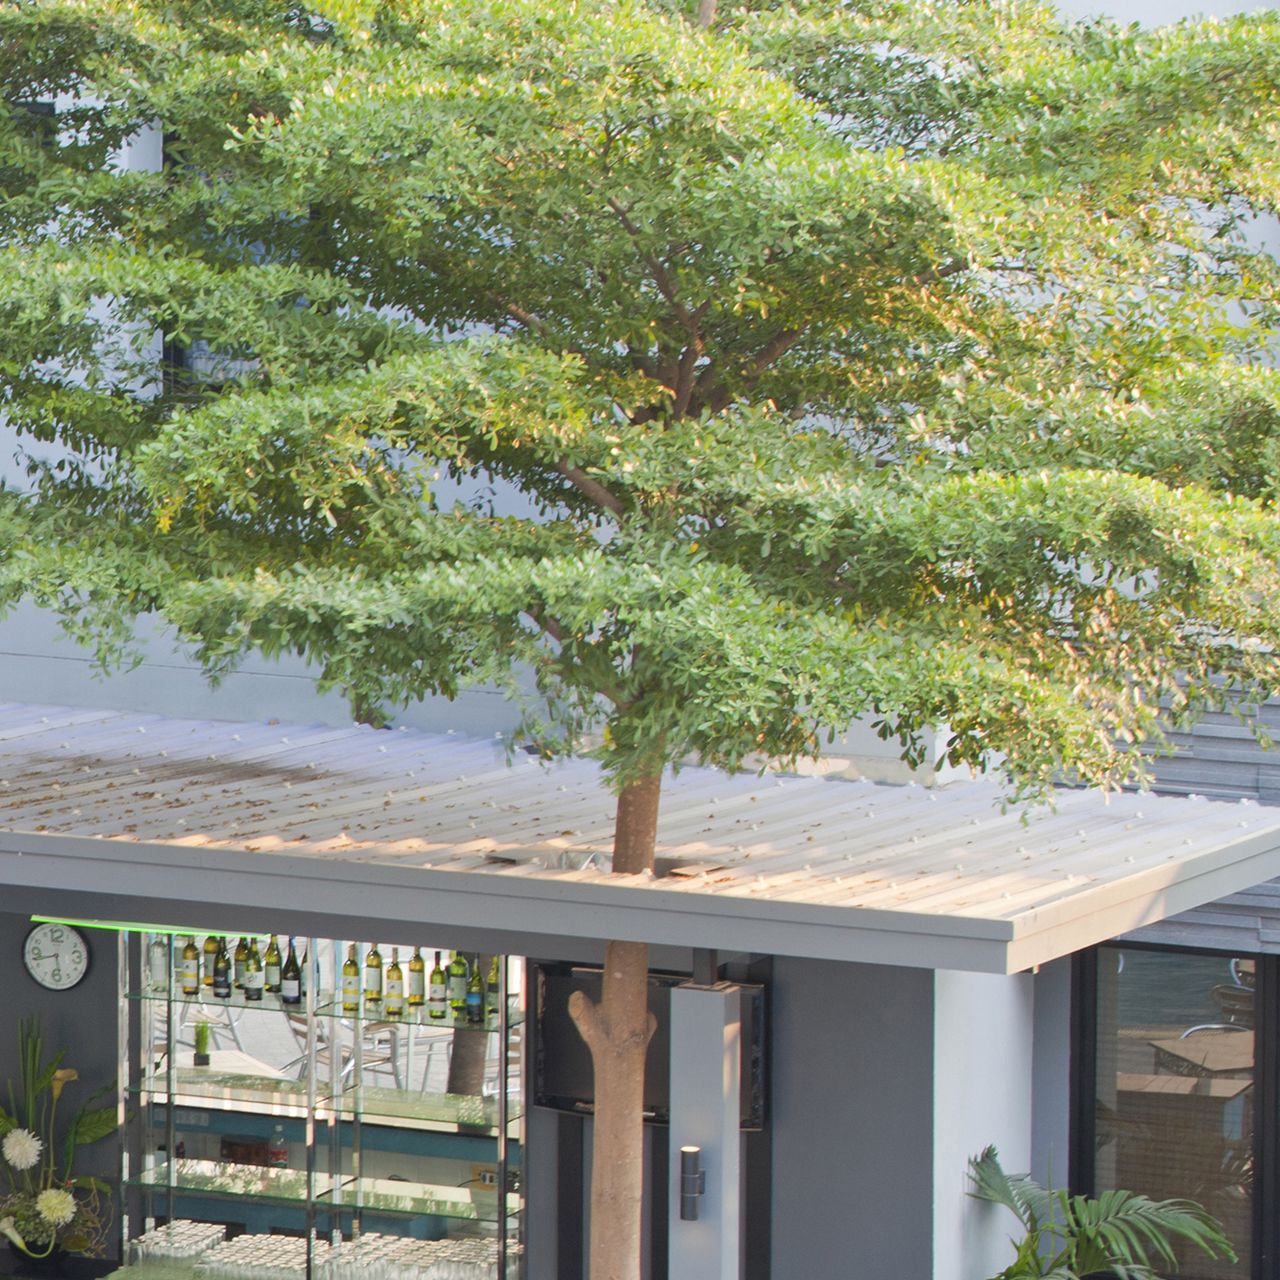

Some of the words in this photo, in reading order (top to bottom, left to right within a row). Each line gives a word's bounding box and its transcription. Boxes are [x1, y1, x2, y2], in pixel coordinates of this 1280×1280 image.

[50, 928, 64, 943] 12
[72, 950, 82, 964] 3
[51, 968, 62, 982] 6
